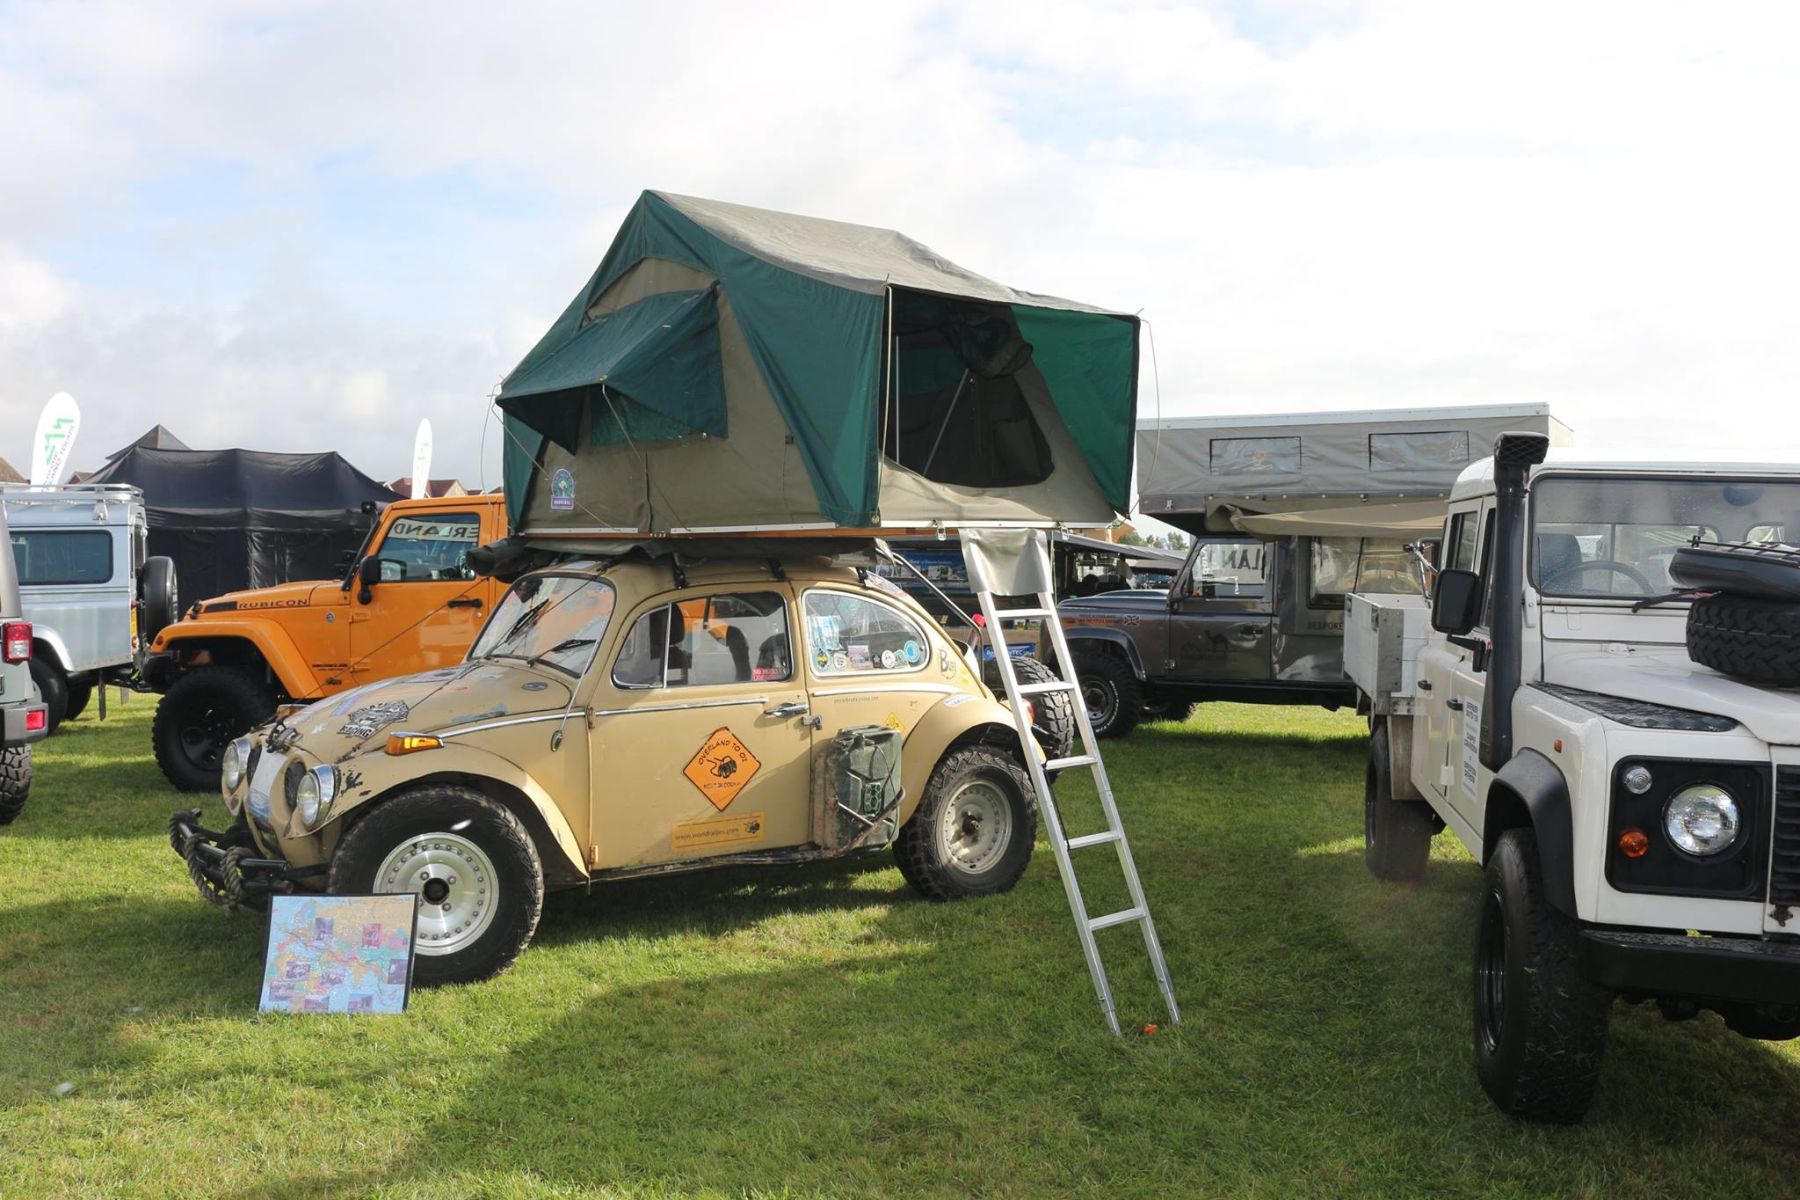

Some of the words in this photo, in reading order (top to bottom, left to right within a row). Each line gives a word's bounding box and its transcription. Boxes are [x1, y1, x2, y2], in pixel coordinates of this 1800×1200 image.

[238, 598, 308, 609] RUBICON
[698, 739, 730, 766] OVERLAND
[732, 742, 741, 752] TO
